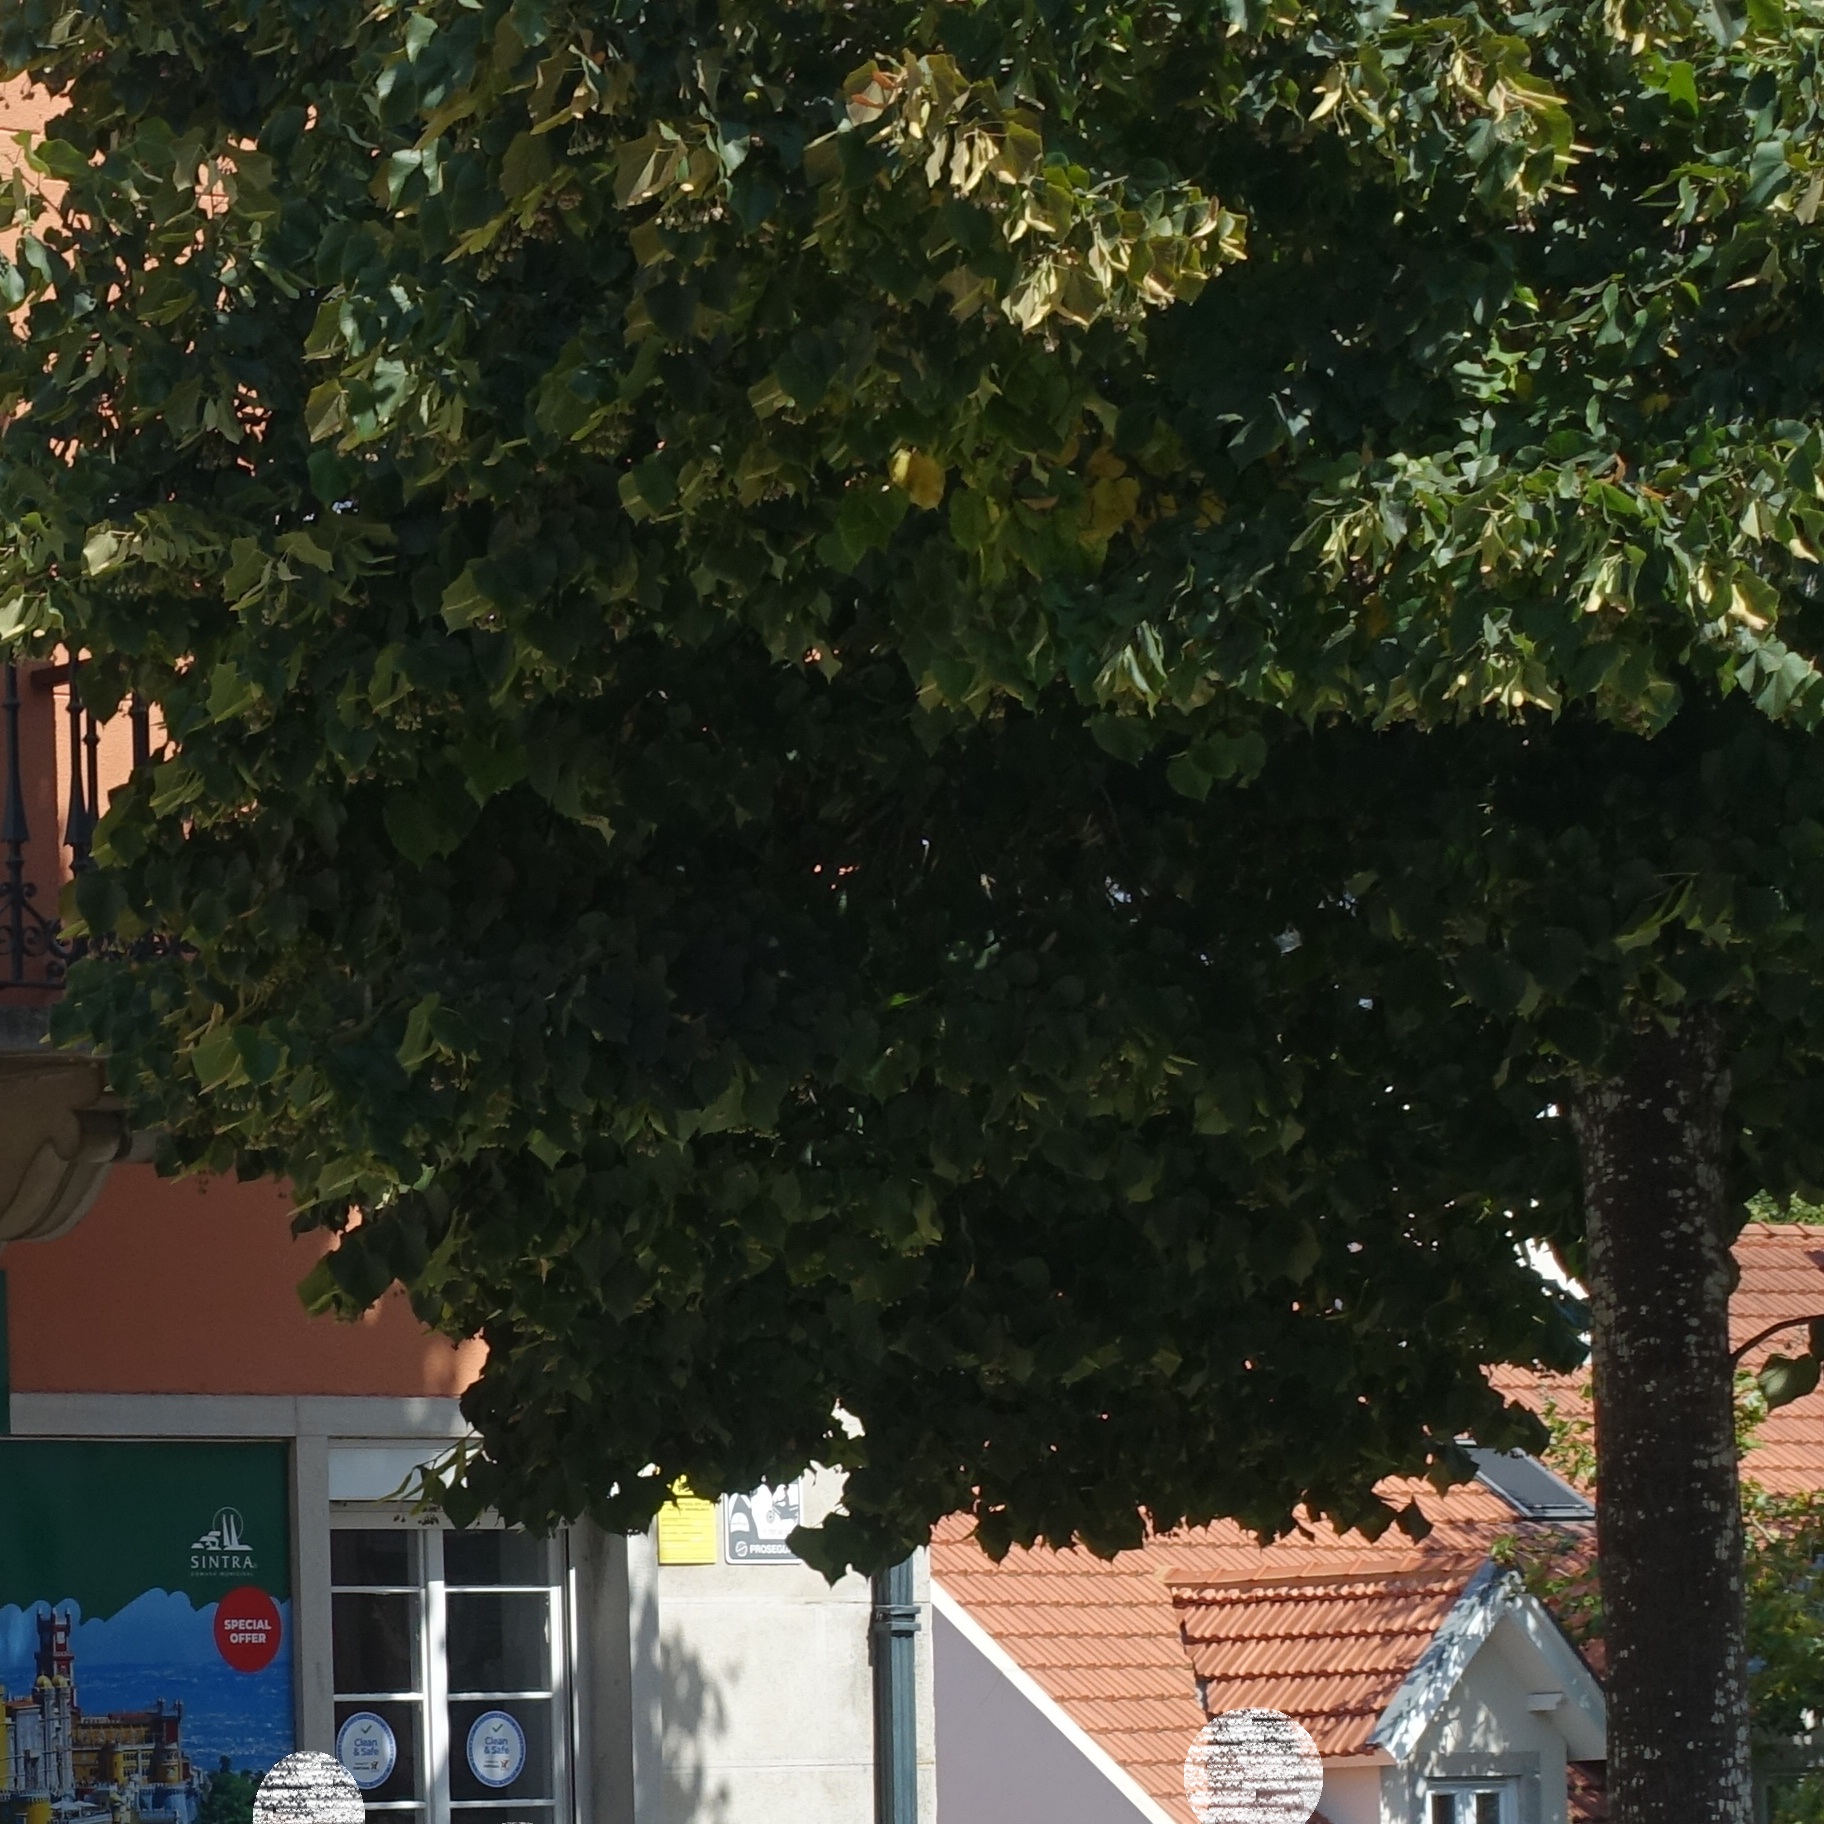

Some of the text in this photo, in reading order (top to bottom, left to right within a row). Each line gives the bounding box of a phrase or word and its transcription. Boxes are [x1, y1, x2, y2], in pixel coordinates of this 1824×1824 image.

[750, 1544, 792, 1554] PROSEGU
[191, 1556, 253, 1568] SINTRA
[224, 1619, 271, 1630] SPECIAL
[230, 1633, 266, 1643] OFFER
[484, 1736, 508, 1745] Clean
[492, 1745, 509, 1754] Safe
